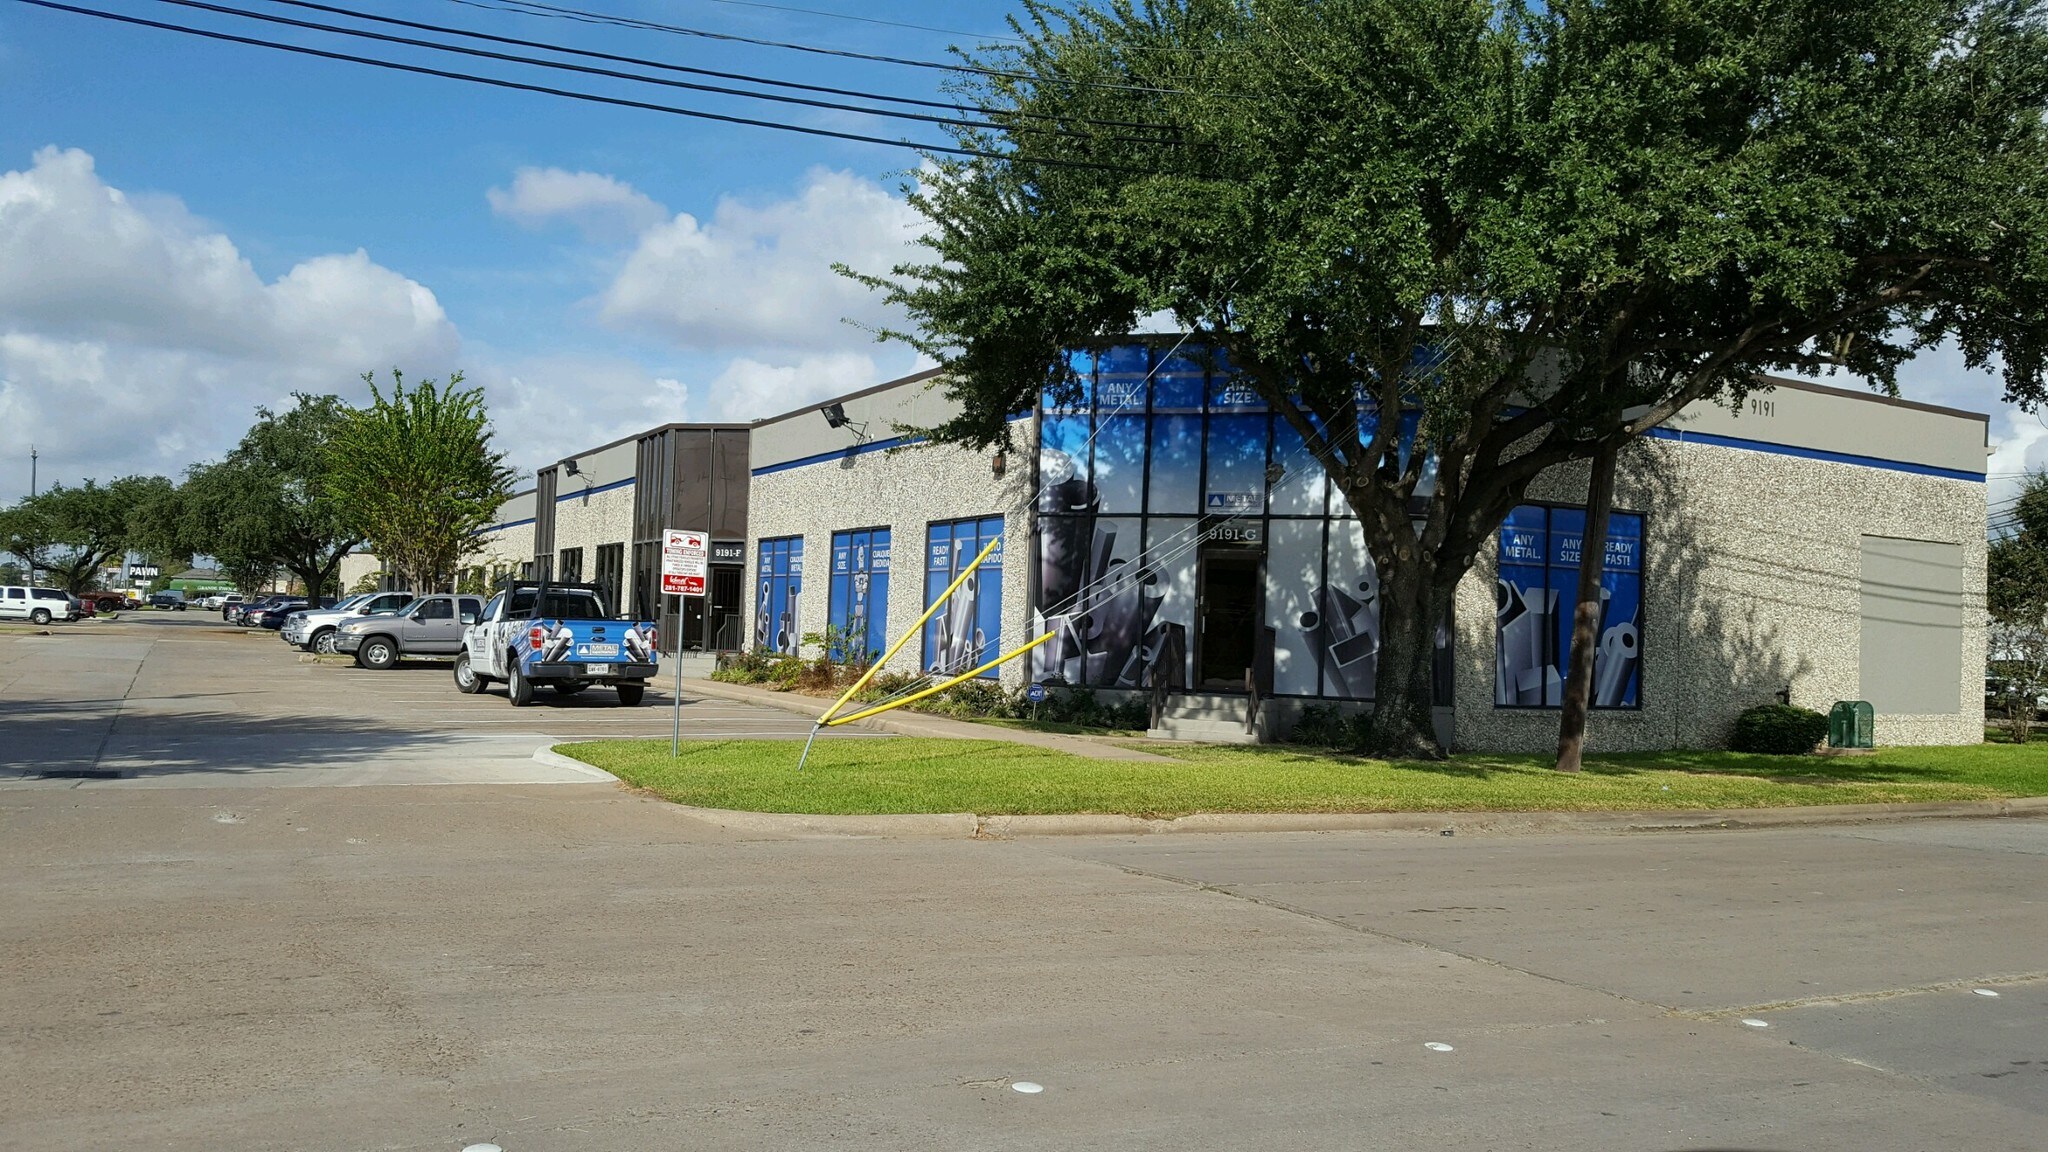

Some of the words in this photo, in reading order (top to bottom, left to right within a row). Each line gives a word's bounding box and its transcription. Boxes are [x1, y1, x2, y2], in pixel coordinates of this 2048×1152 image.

[1107, 383, 1133, 393] ANY
[1100, 394, 1143, 405] METAL.
[1223, 392, 1255, 404] SIZE.
[1751, 399, 1774, 417] 9191
[1209, 529, 1256, 540] 9191-G
[1513, 534, 1534, 546] ANY
[1562, 538, 1582, 550] ANY
[932, 546, 949, 555] READY
[1505, 546, 1541, 559] METAL.
[934, 556, 948, 566] FAST!
[1605, 553, 1631, 566] FAST!
[130, 566, 158, 576] PAWN
